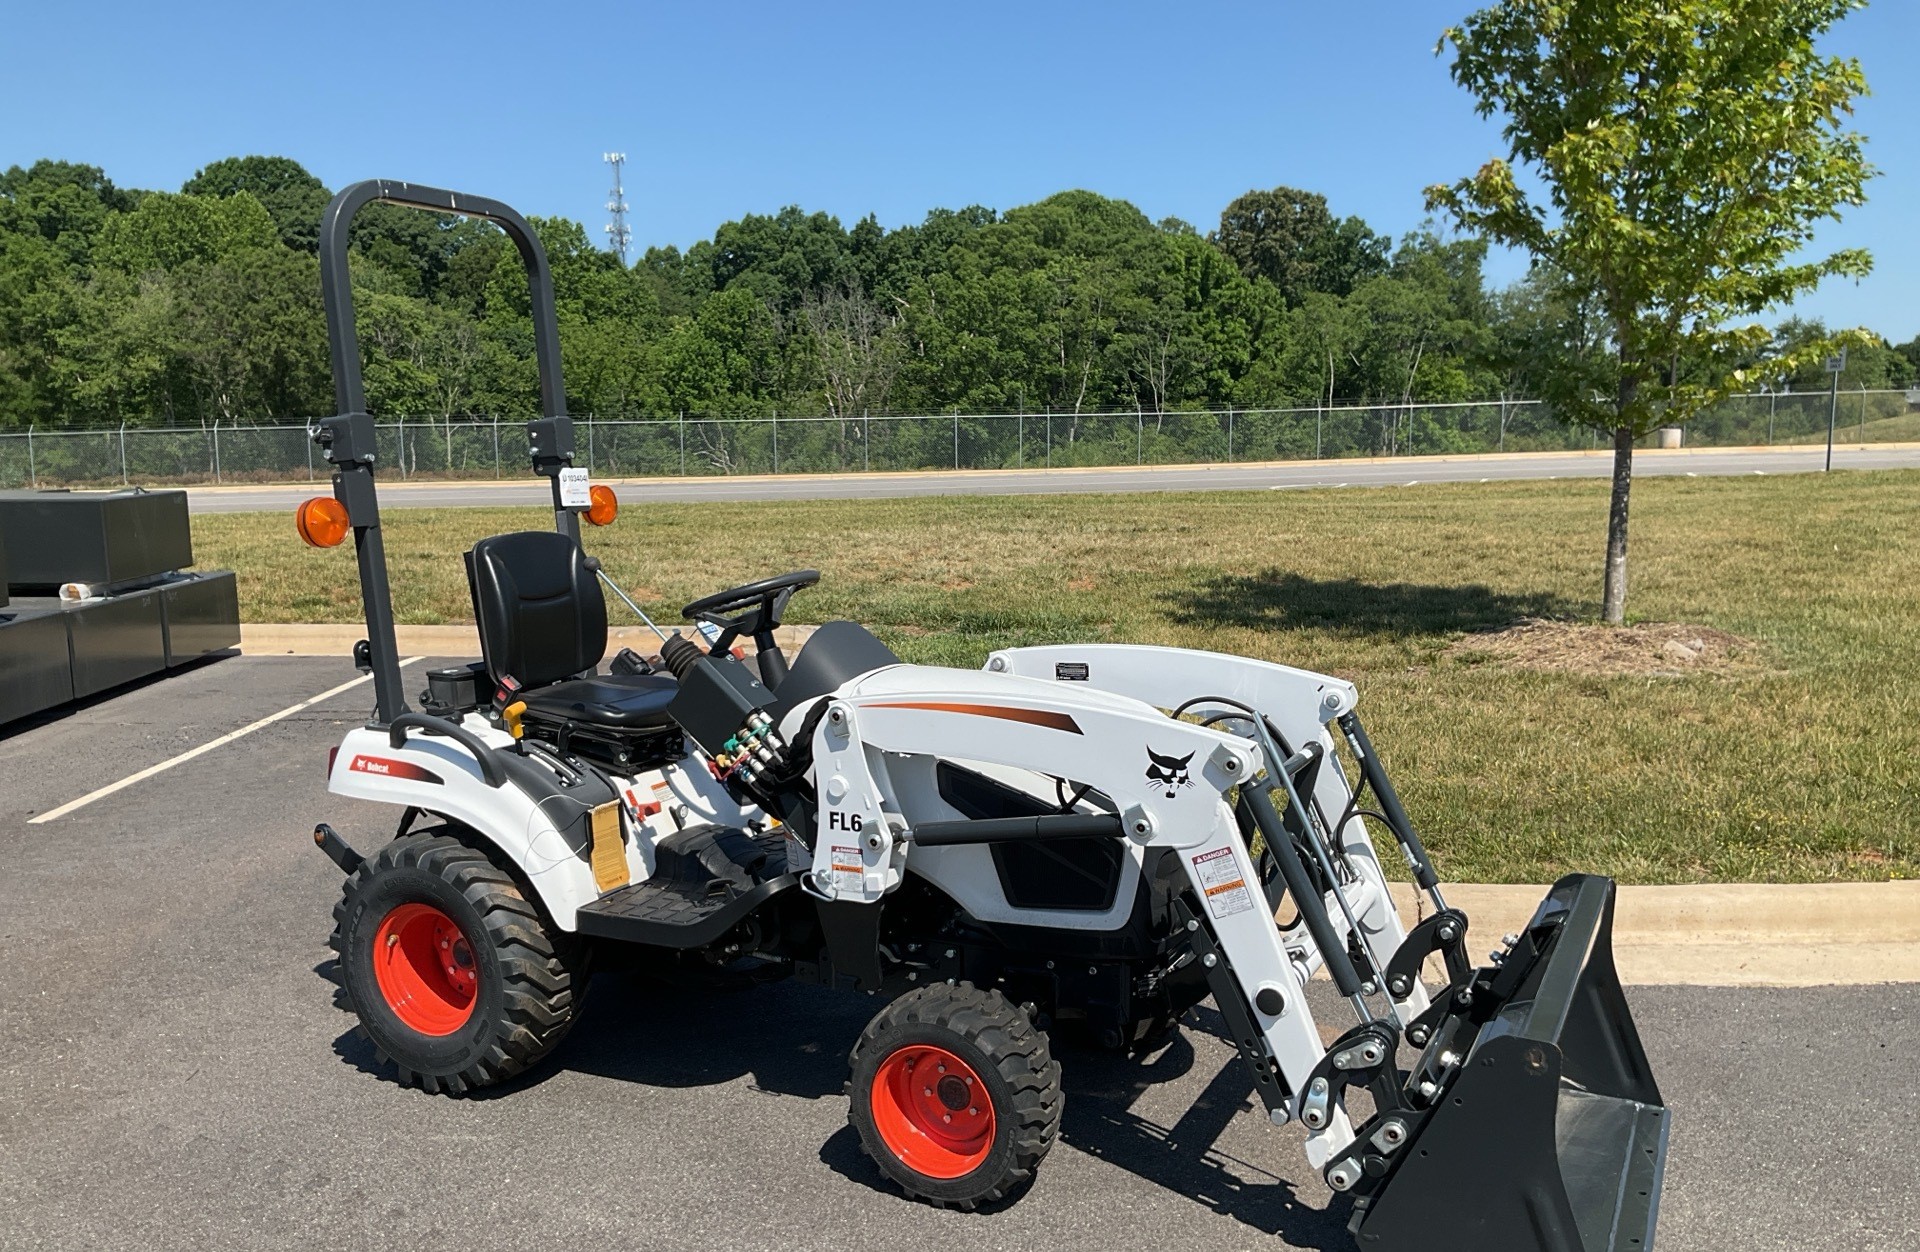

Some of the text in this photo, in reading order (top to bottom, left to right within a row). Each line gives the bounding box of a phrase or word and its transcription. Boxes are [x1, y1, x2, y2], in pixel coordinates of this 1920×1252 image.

[367, 761, 390, 774] Bobcat
[829, 811, 863, 832] FL6
[1202, 849, 1230, 861] DANGER
[1215, 882, 1242, 895] WARNING
